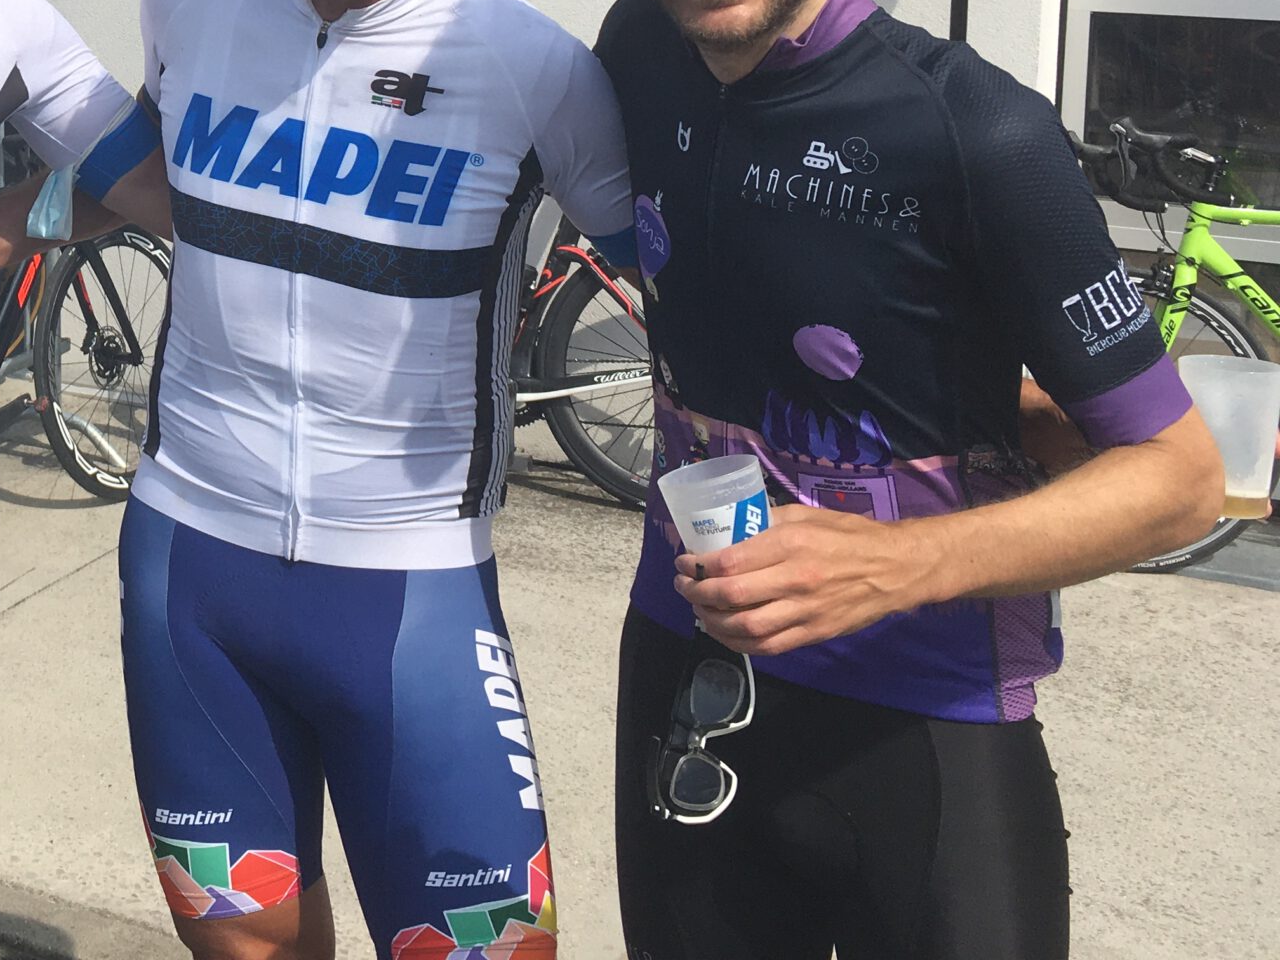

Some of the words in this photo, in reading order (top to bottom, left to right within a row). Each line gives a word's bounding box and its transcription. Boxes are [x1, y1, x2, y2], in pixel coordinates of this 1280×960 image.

[172, 92, 471, 227] MAPEI
[743, 163, 891, 216] MACHINES
[740, 189, 795, 213] KALE
[820, 207, 918, 234] MANNEN
[1086, 327, 1129, 357] BIERCLUB
[744, 503, 762, 540] PEI
[475, 628, 546, 812] MAPEI
[154, 808, 234, 825] Santini
[425, 864, 513, 889] Santini
